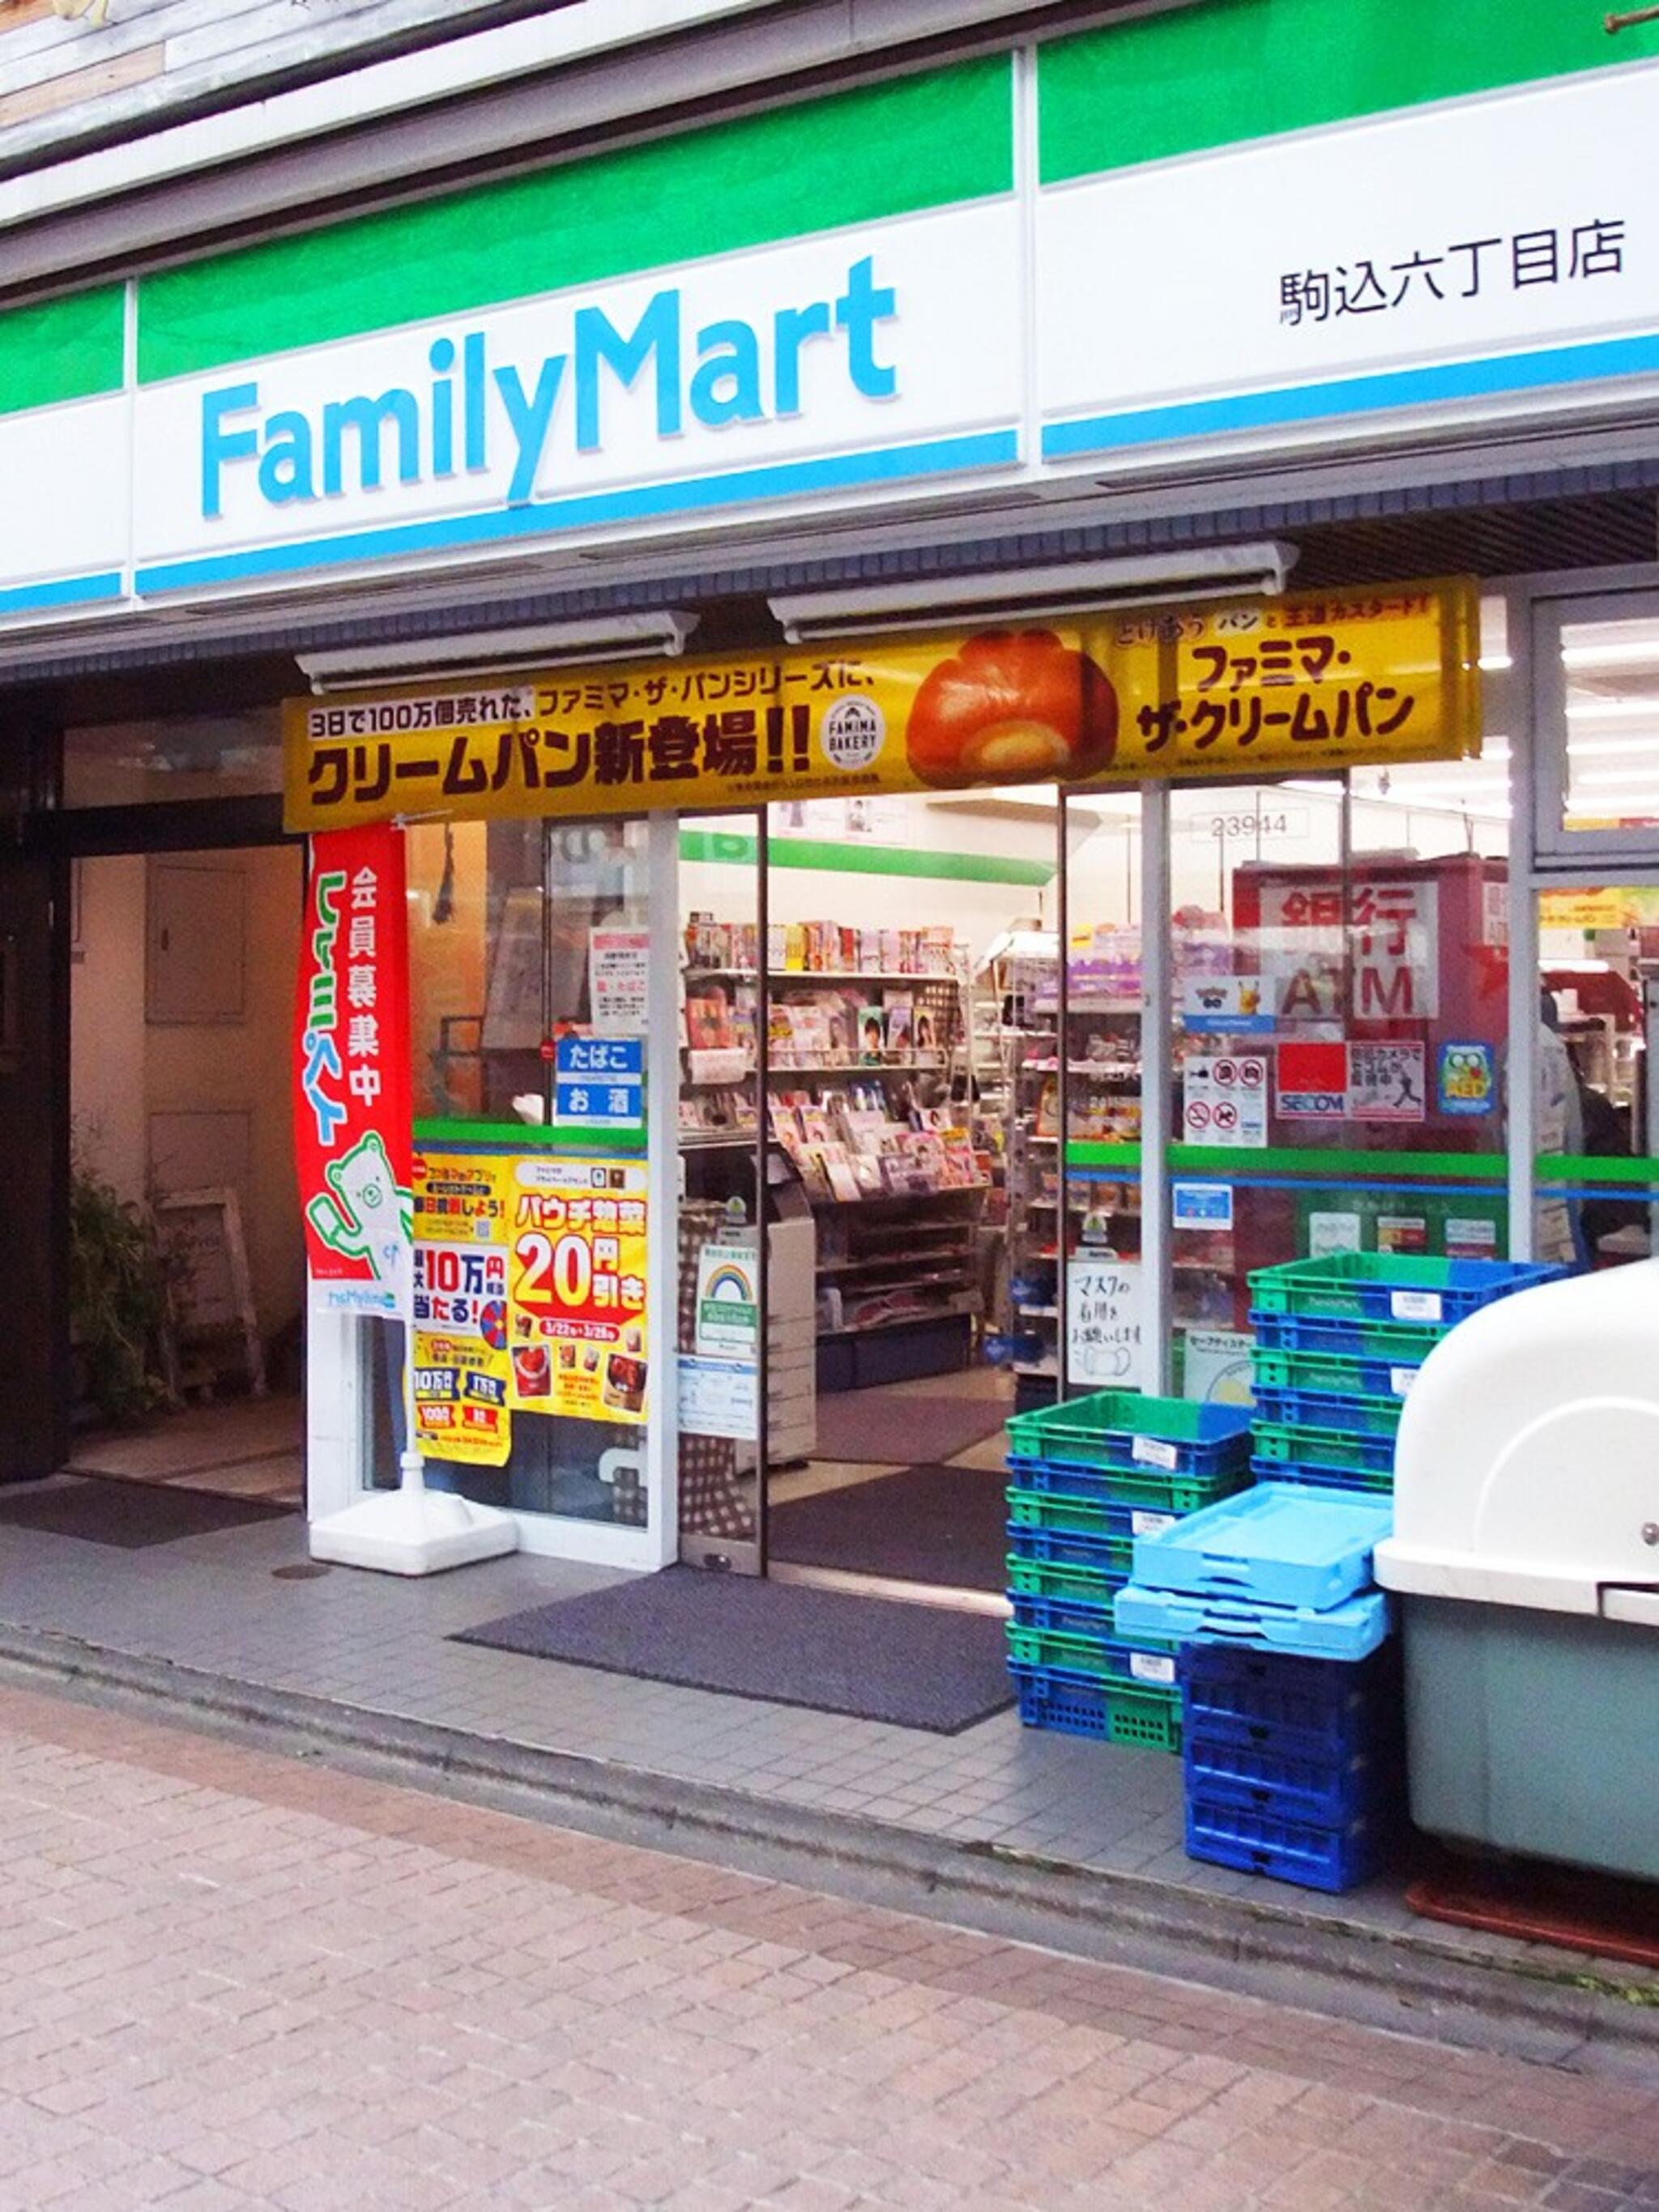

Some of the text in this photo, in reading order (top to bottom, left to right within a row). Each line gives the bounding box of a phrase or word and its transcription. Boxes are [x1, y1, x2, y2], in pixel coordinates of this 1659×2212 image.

[1279, 219, 1624, 326] 駒込六丁目店
[202, 255, 898, 509] FamilyMart
[829, 718, 876, 735] FAMIMA
[829, 735, 876, 752] BAKERY
[569, 1044, 628, 1069] たばこ
[1281, 1093, 1345, 1112] SECOM
